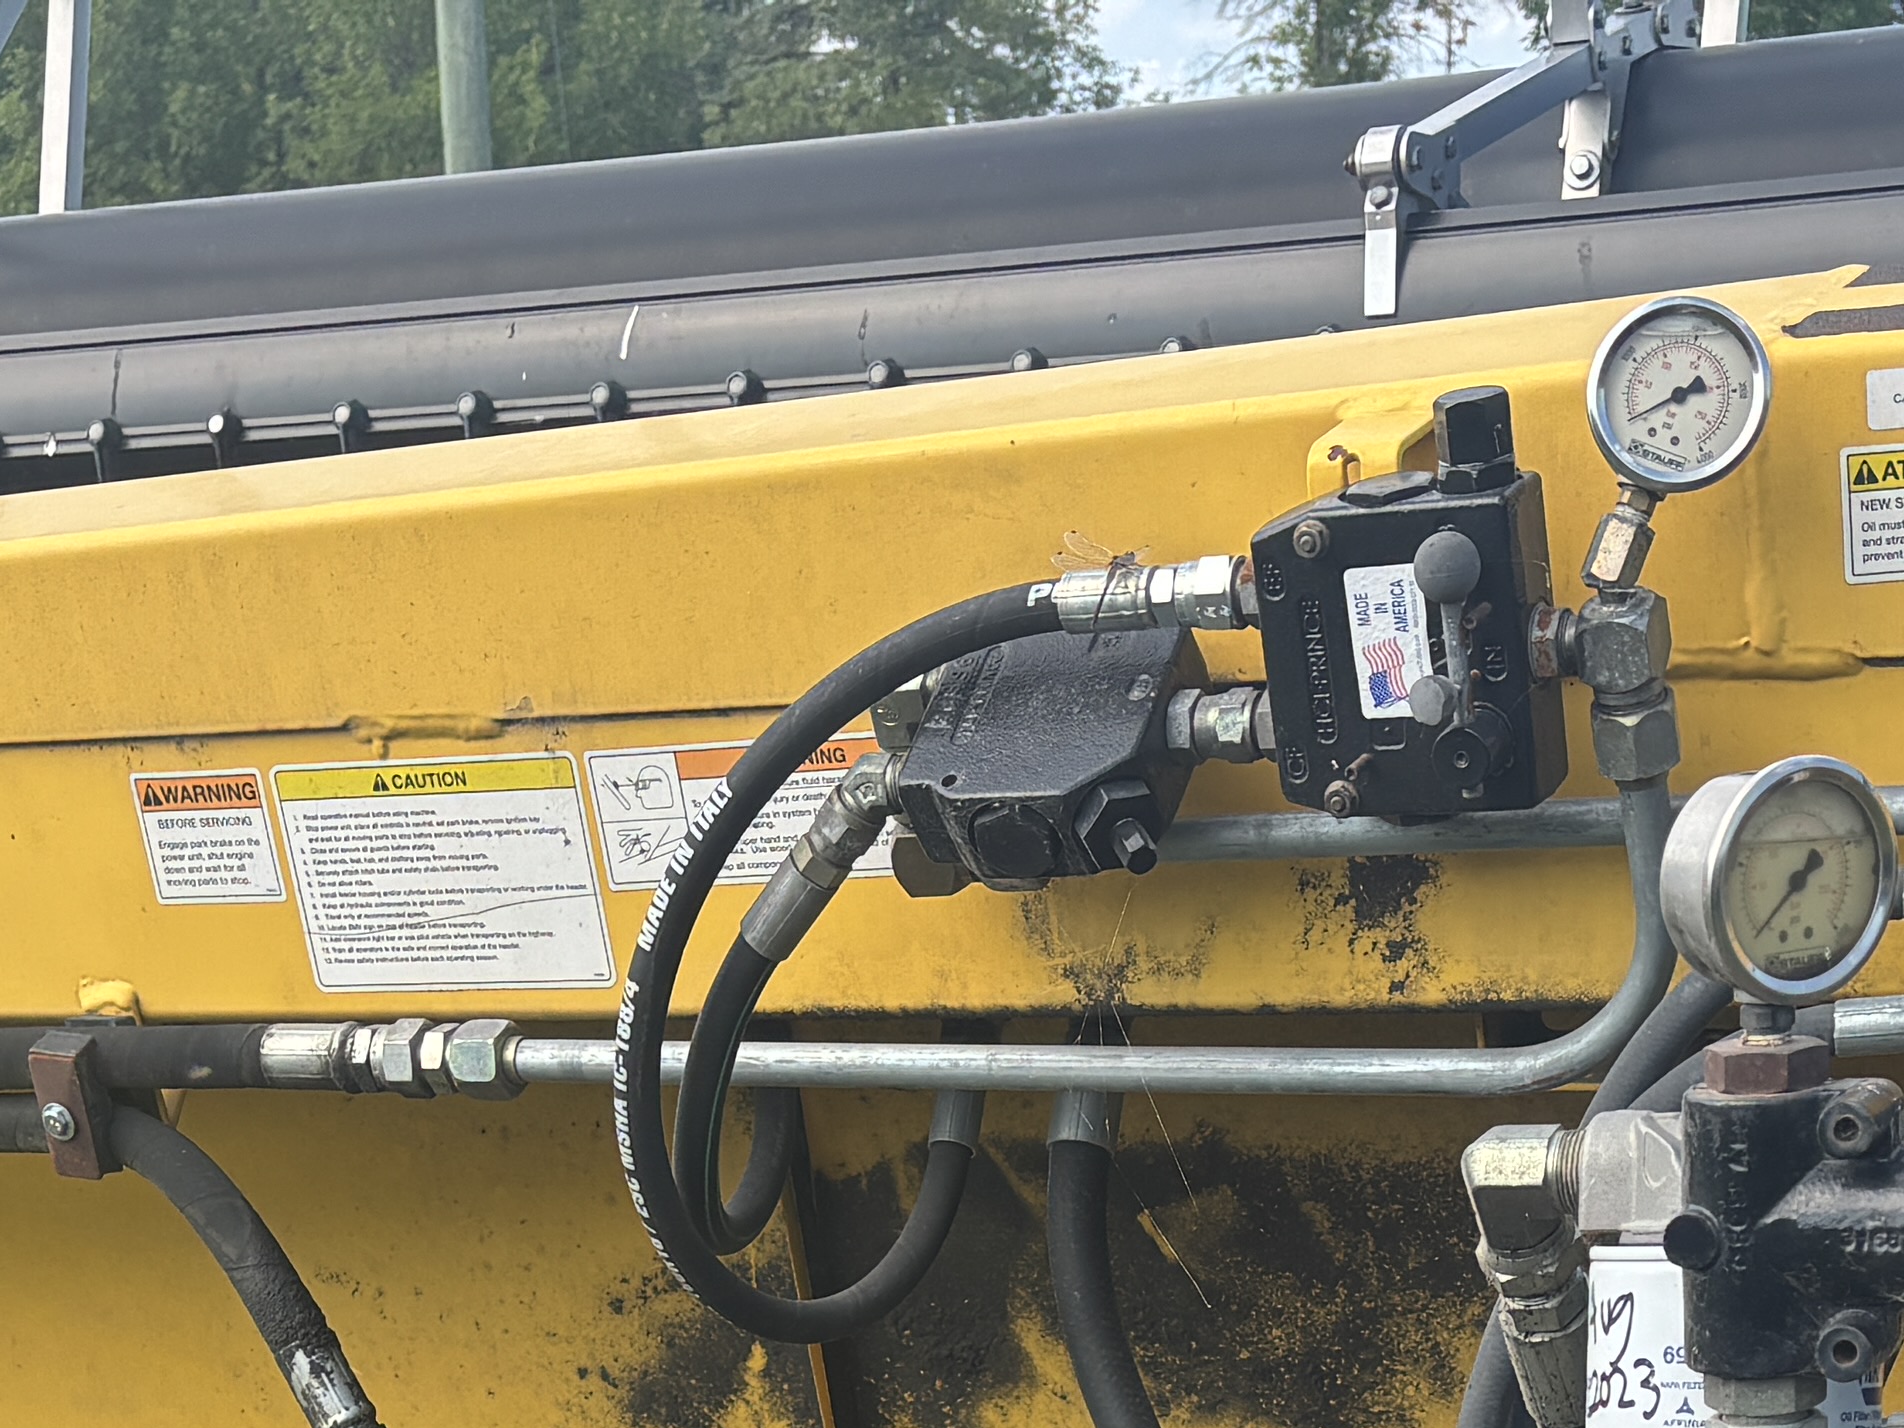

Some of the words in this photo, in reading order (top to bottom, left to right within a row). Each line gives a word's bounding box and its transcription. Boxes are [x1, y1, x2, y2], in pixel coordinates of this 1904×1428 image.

[1860, 499, 1891, 512] NEW
[1861, 521, 1877, 533] Oil
[1862, 537, 1882, 547] and
[1862, 550, 1903, 563] prevent
[1353, 592, 1371, 627] MADE
[1373, 601, 1389, 614] IN
[1389, 578, 1410, 633] AMERICA
[802, 747, 846, 765] NING
[391, 770, 467, 789] CAUTION
[159, 781, 257, 804] WARNING
[157, 817, 197, 829] BEFORE
[200, 816, 252, 828] SERVICING
[637, 876, 677, 951] MADE
[670, 842, 695, 876] IN
[690, 780, 733, 842] ITALY
[613, 1097, 637, 1171] MSHA
[1587, 1358, 1662, 1420] 2023
